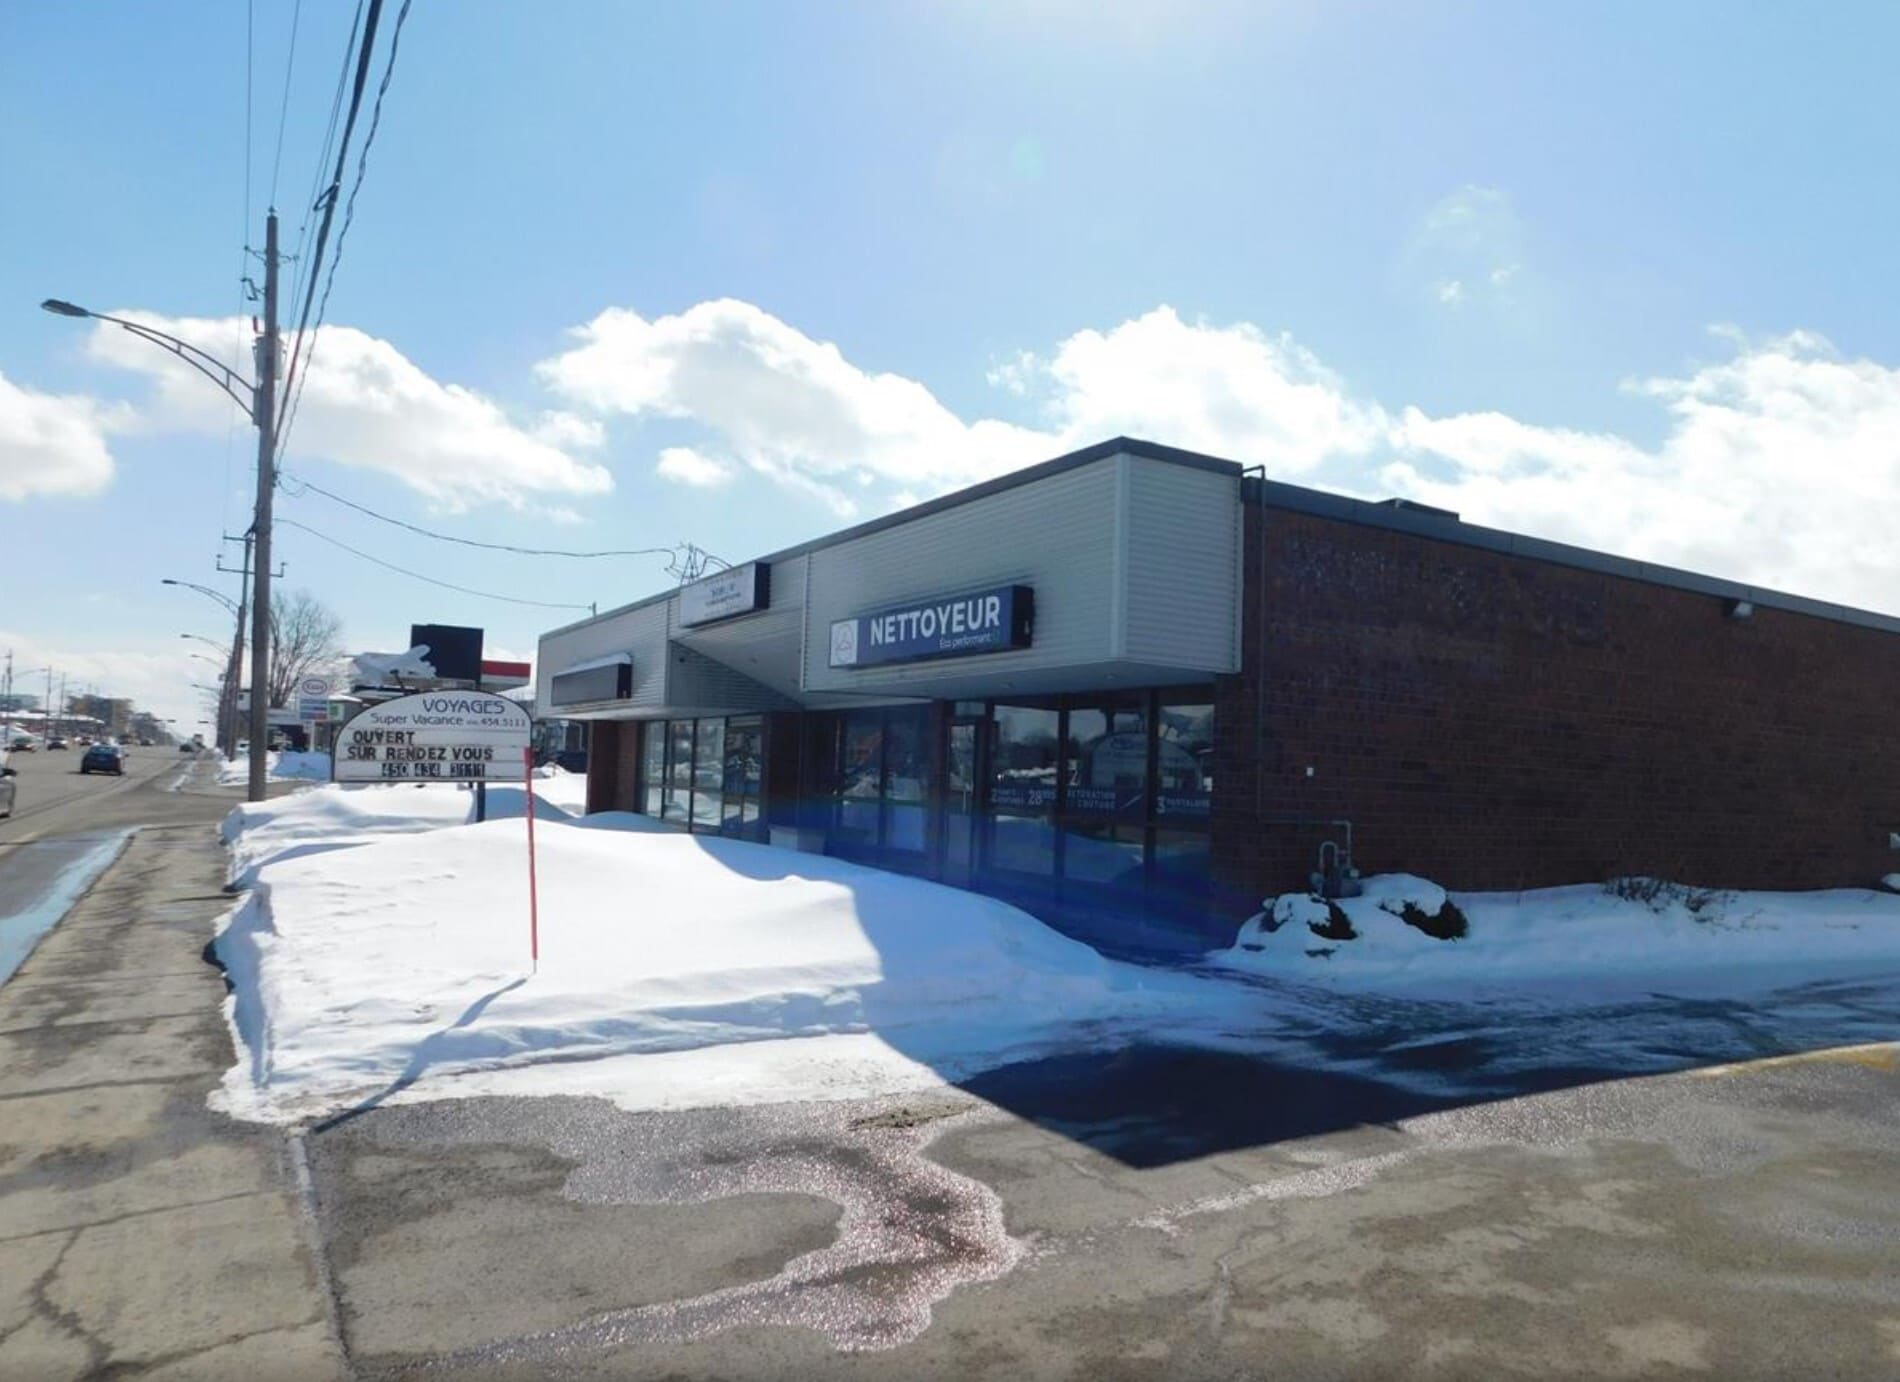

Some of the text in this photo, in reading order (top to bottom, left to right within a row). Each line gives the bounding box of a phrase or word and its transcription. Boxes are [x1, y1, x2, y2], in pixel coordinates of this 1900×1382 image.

[870, 596, 1000, 645] NETTOYEUR
[422, 699, 506, 715] VOYAGES
[370, 712, 407, 725] Super
[412, 713, 464, 726] Vacance
[353, 730, 415, 744] OUVERT
[347, 746, 494, 760] SUR RENDEZ VOUS
[382, 762, 408, 777] 450
